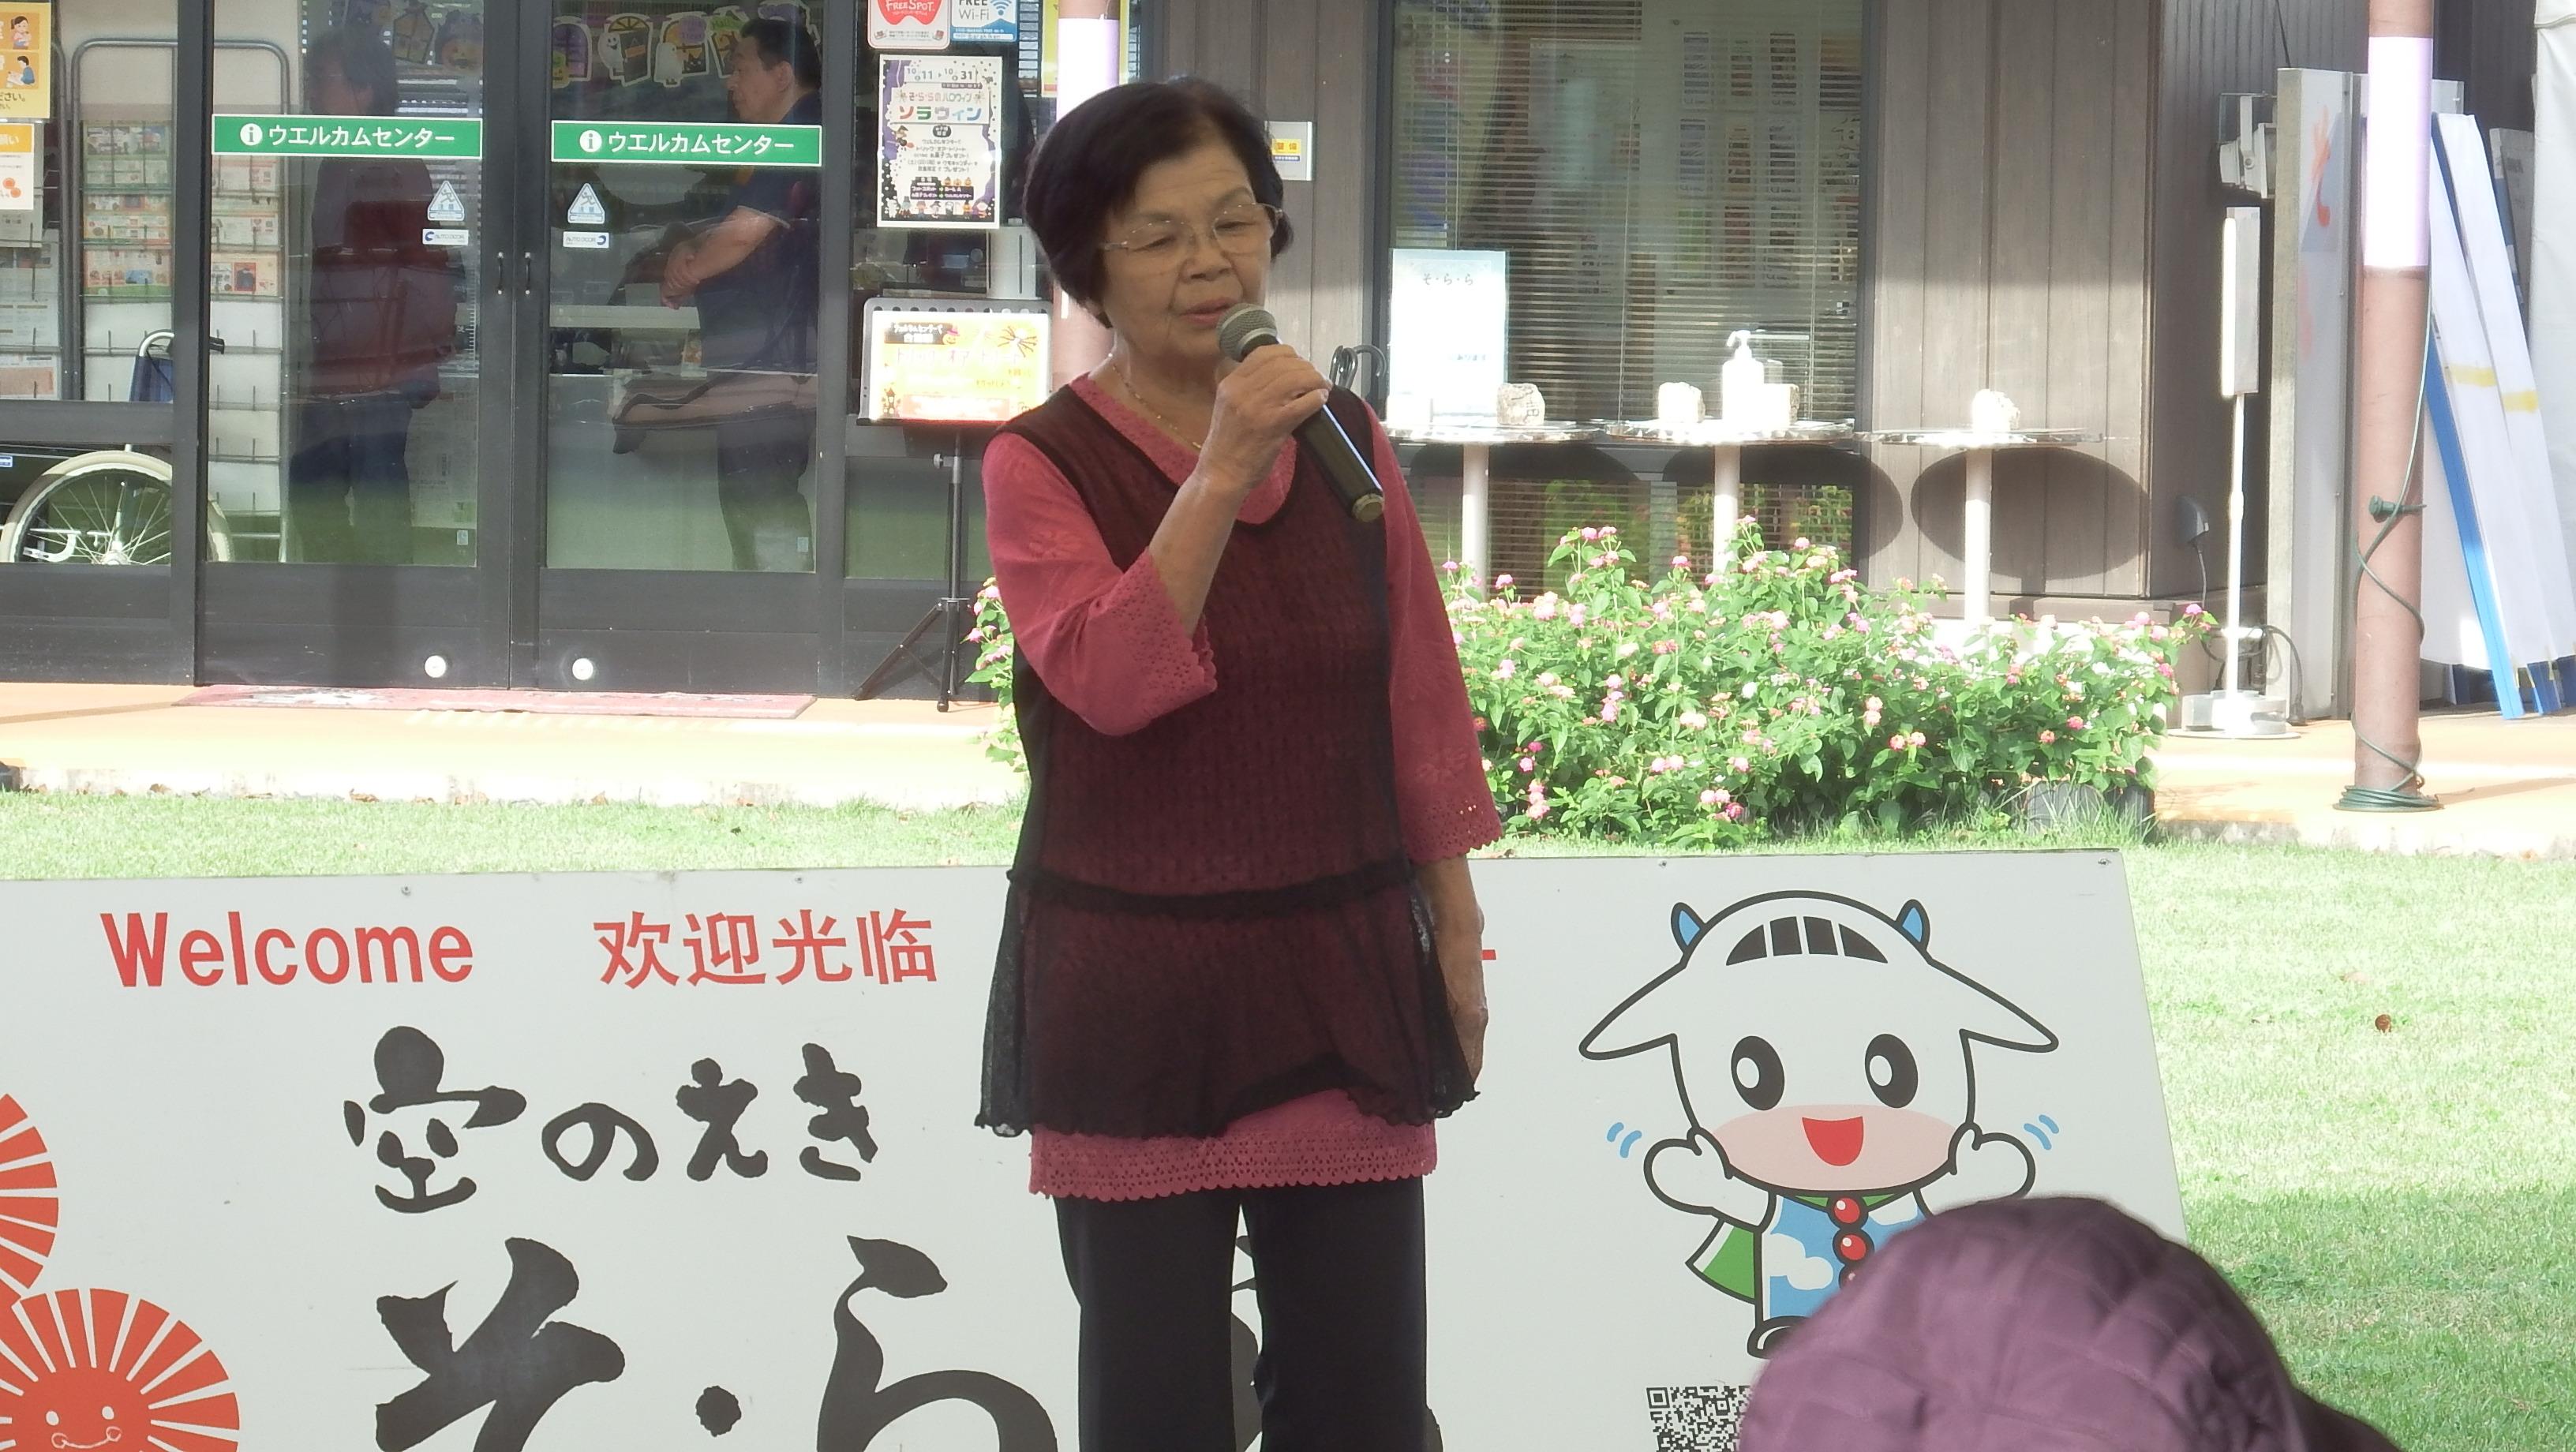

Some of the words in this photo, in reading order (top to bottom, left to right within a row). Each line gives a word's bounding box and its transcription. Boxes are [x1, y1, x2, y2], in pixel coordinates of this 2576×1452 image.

[958, 9, 990, 21] Wi-Fi
[899, 105, 982, 121] ソラウィン
[268, 124, 455, 148] ウエルカムセンター
[607, 130, 794, 154] ウエルカムセンター
[1422, 273, 1474, 286] そ・ら・ら
[101, 911, 474, 987] Welcome
[593, 908, 937, 989] 欢迎光临
[344, 1026, 878, 1214] 空のえき
